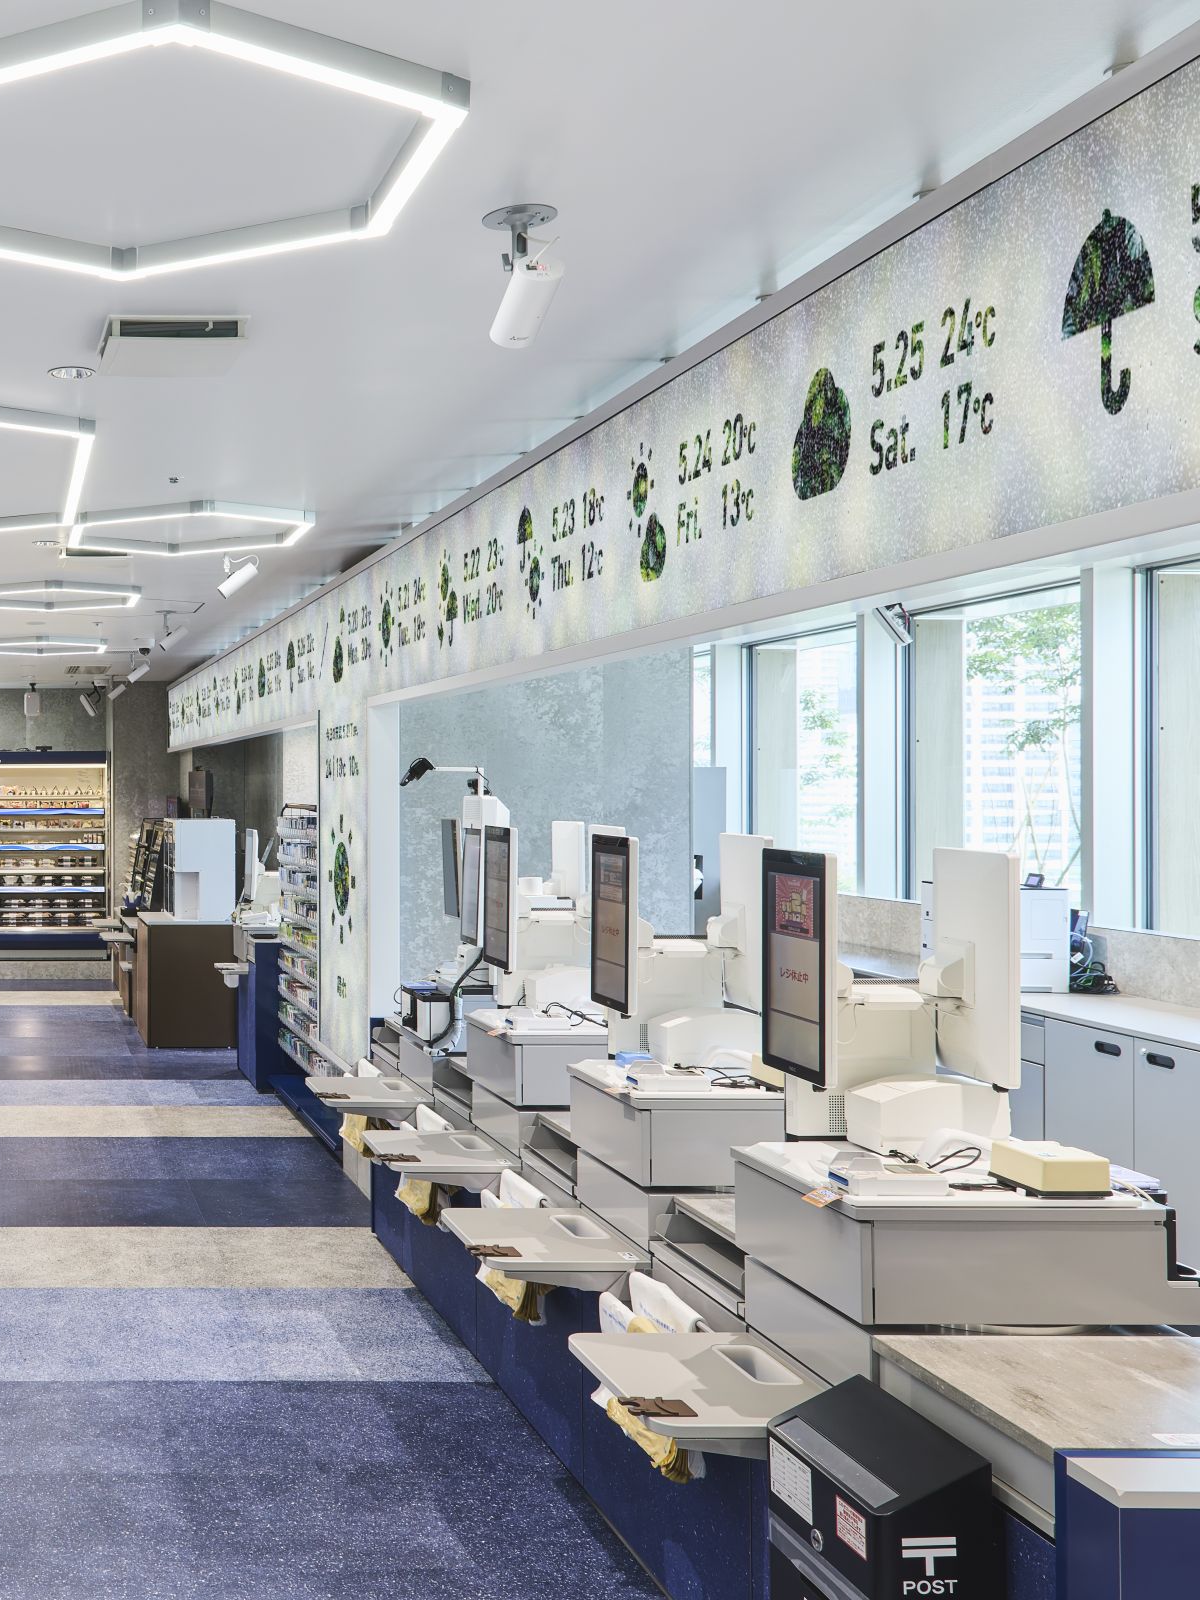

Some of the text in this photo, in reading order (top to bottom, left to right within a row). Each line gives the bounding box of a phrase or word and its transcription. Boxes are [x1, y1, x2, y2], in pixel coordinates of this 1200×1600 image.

[871, 320, 925, 398] 5.25
[678, 428, 713, 485] 5.24
[869, 414, 916, 476] Sat.
[552, 498, 576, 543] 5.23
[676, 496, 702, 547] Fri.
[463, 546, 481, 582] 5.22
[551, 554, 574, 592] Thu.
[462, 588, 483, 624] Wed.
[780, 967, 809, 984] レジ休止中
[903, 1579, 958, 1596] POST
